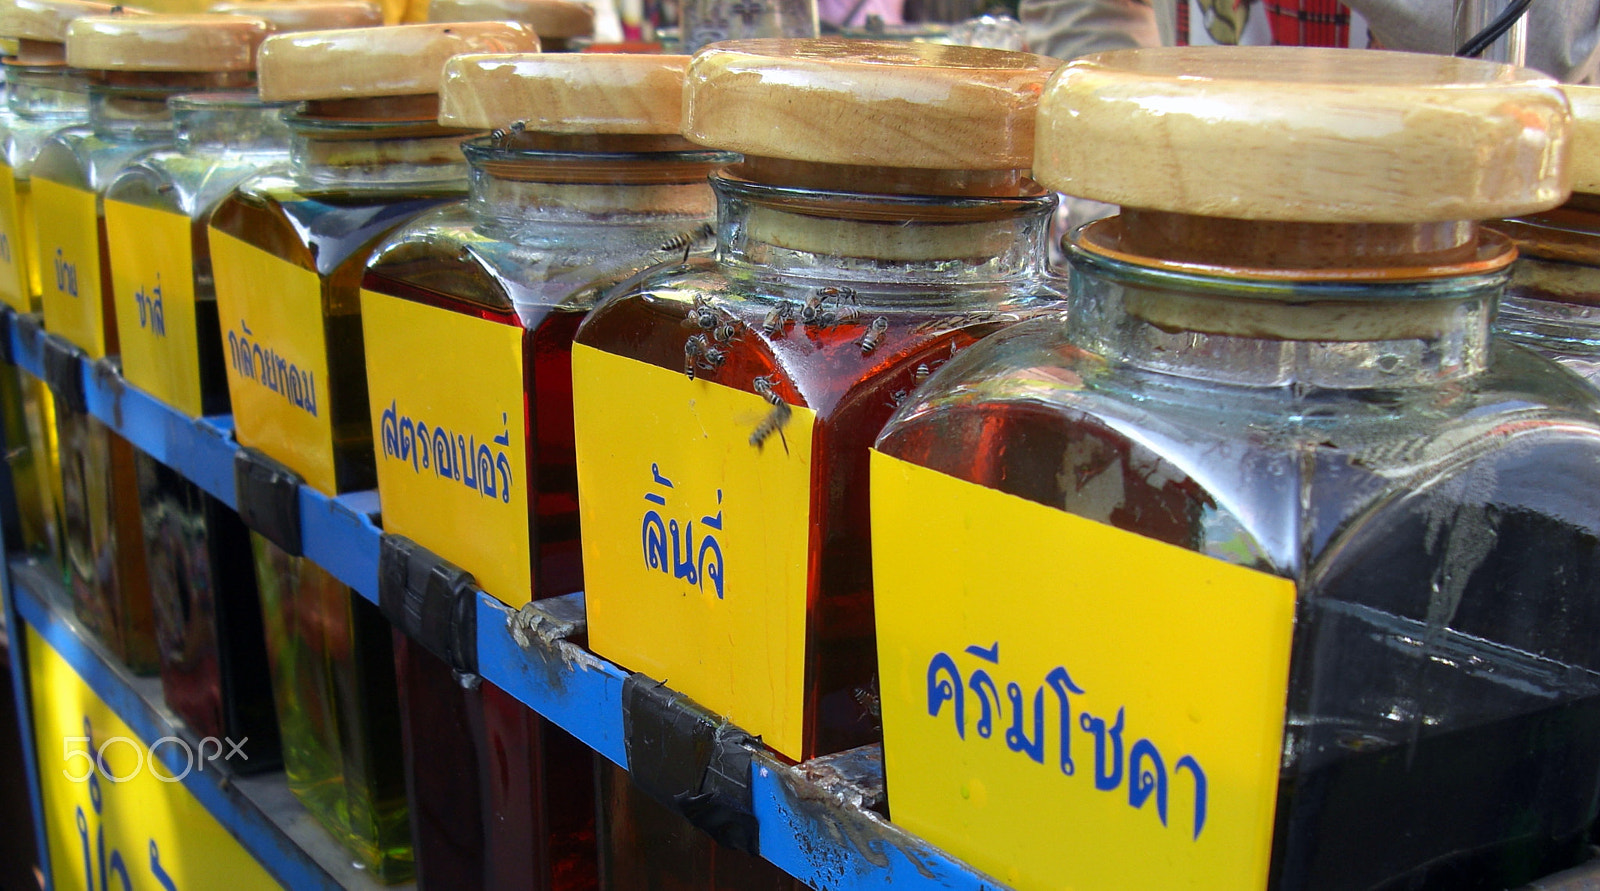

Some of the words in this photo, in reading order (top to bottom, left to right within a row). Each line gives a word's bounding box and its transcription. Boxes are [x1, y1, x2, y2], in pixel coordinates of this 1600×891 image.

[227, 318, 318, 417] กล้วยหอม
[381, 398, 514, 504] สตรอเบอรี่
[641, 462, 725, 600] ลิ้นจี่
[927, 641, 1208, 842] ครีมโซดา
